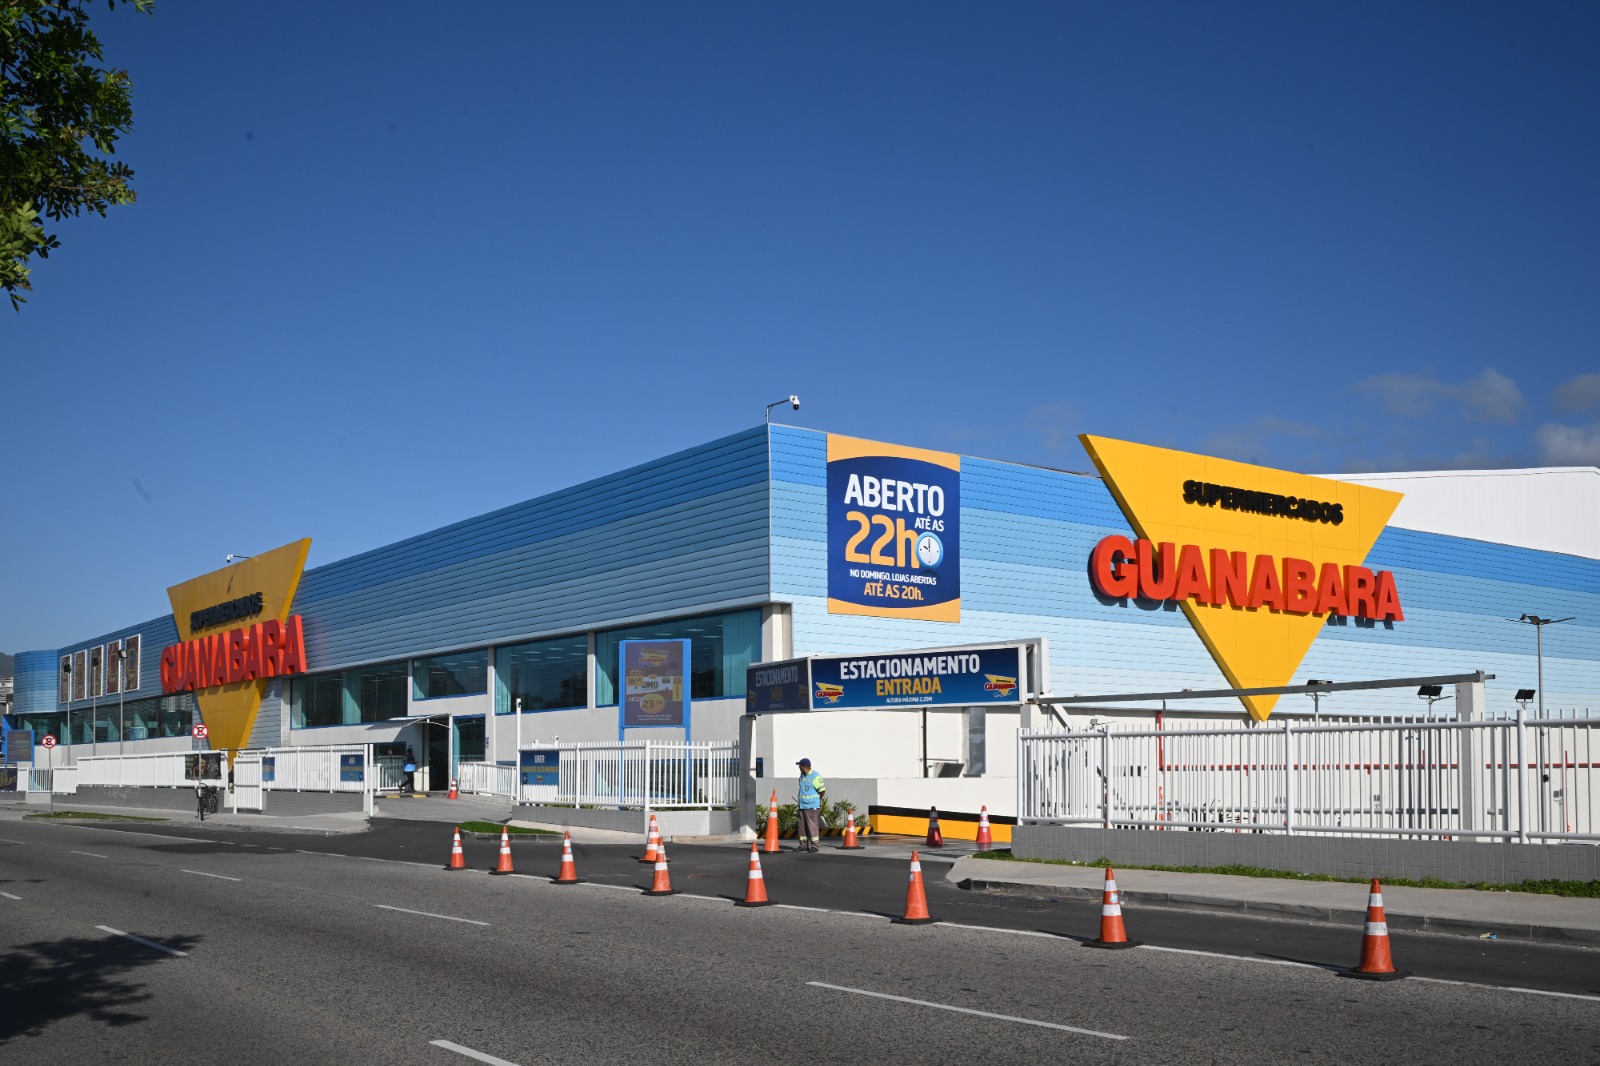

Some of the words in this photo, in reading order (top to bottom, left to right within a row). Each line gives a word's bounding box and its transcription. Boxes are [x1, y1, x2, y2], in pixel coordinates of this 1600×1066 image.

[844, 474, 945, 516] ABERTO
[1183, 480, 1344, 526] SUPERMERCADOS
[915, 515, 931, 531] ATÉ
[931, 519, 945, 532] AS
[845, 511, 920, 569] 22h
[849, 568, 860, 578] NO
[891, 573, 910, 583] LOJAS
[909, 574, 937, 586] ABERTAS
[863, 580, 884, 597] ATÉ
[885, 584, 900, 599] AS
[901, 585, 924, 600] 20h.
[1092, 534, 1405, 621] GUANABARA
[190, 591, 263, 633] SUPERMERCADOS
[160, 615, 307, 693] GUANABARA
[840, 654, 980, 680] ESTACIONAMENTO
[755, 665, 798, 688] ESTACIONAMENTO
[876, 677, 942, 697] ENTRADA
[534, 754, 546, 764] UBER
